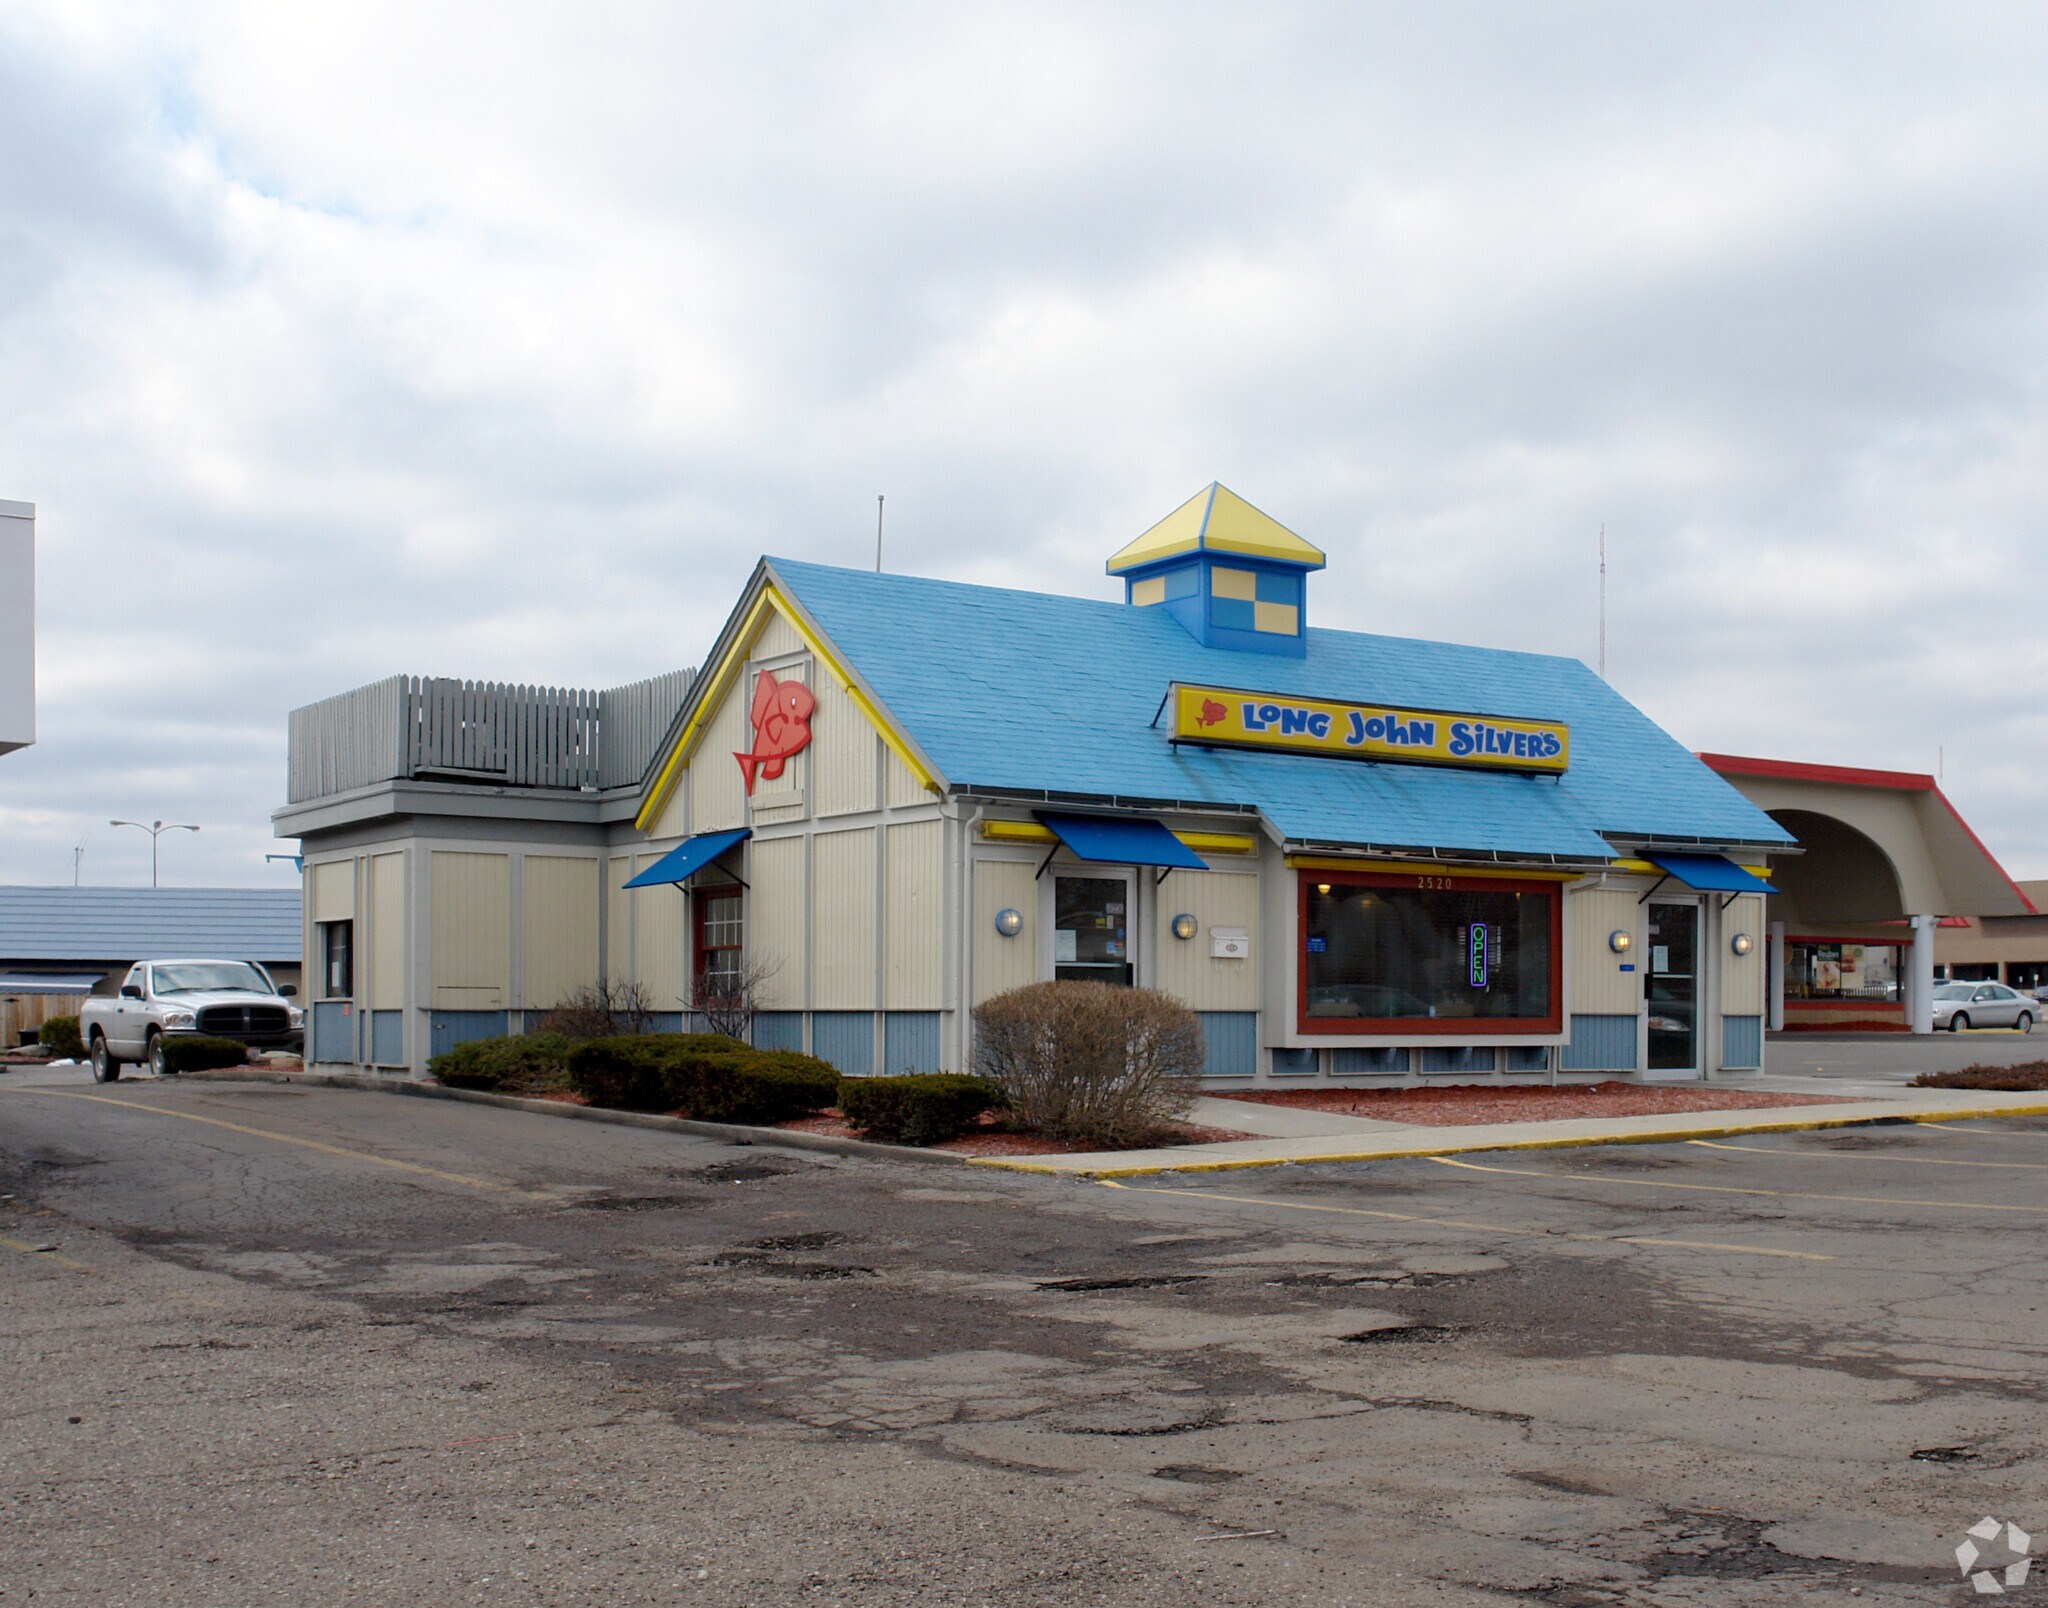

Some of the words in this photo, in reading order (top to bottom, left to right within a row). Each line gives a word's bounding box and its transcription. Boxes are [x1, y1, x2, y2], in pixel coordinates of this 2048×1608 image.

[1242, 703, 1331, 738] LONG
[1418, 876, 1452, 889] 2520
[1473, 927, 1484, 983] OPEN
